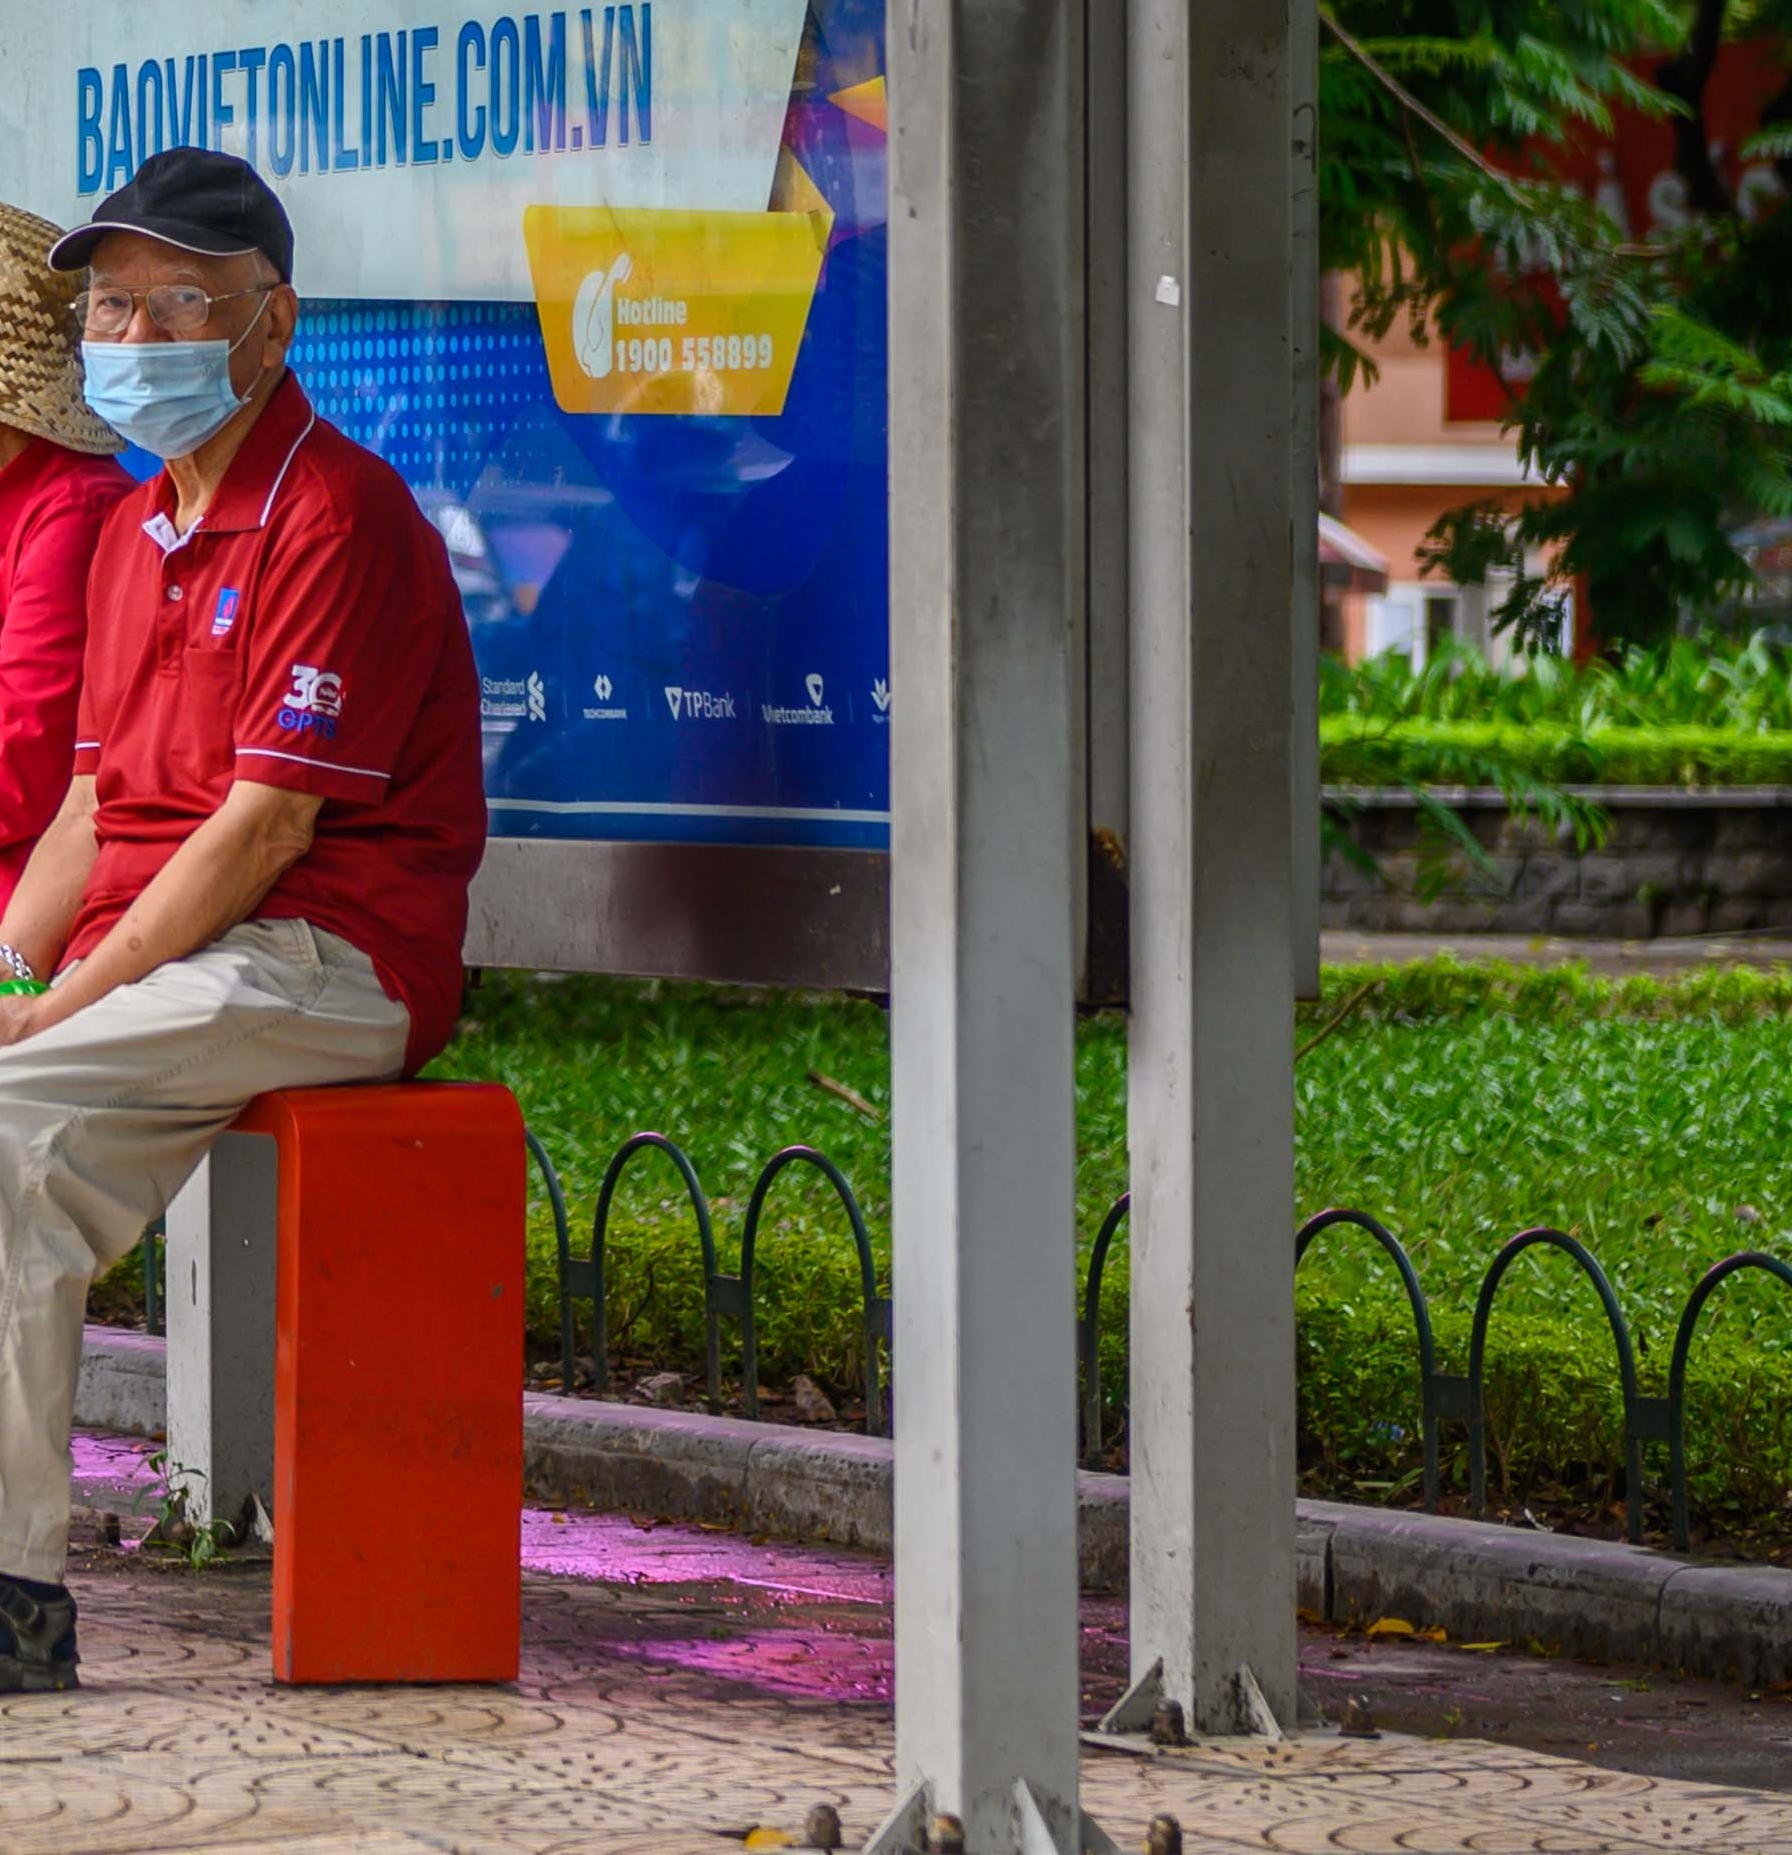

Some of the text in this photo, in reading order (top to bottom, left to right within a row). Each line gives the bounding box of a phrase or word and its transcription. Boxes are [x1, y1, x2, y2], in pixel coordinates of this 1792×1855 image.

[76, 2, 652, 198] BAOVIETONLINE.COM.VN
[617, 297, 688, 325] Hotline
[617, 333, 773, 373] 1900 558899
[482, 677, 525, 695] Standard
[683, 691, 737, 719] TPBank
[762, 704, 834, 725] Vietcombank
